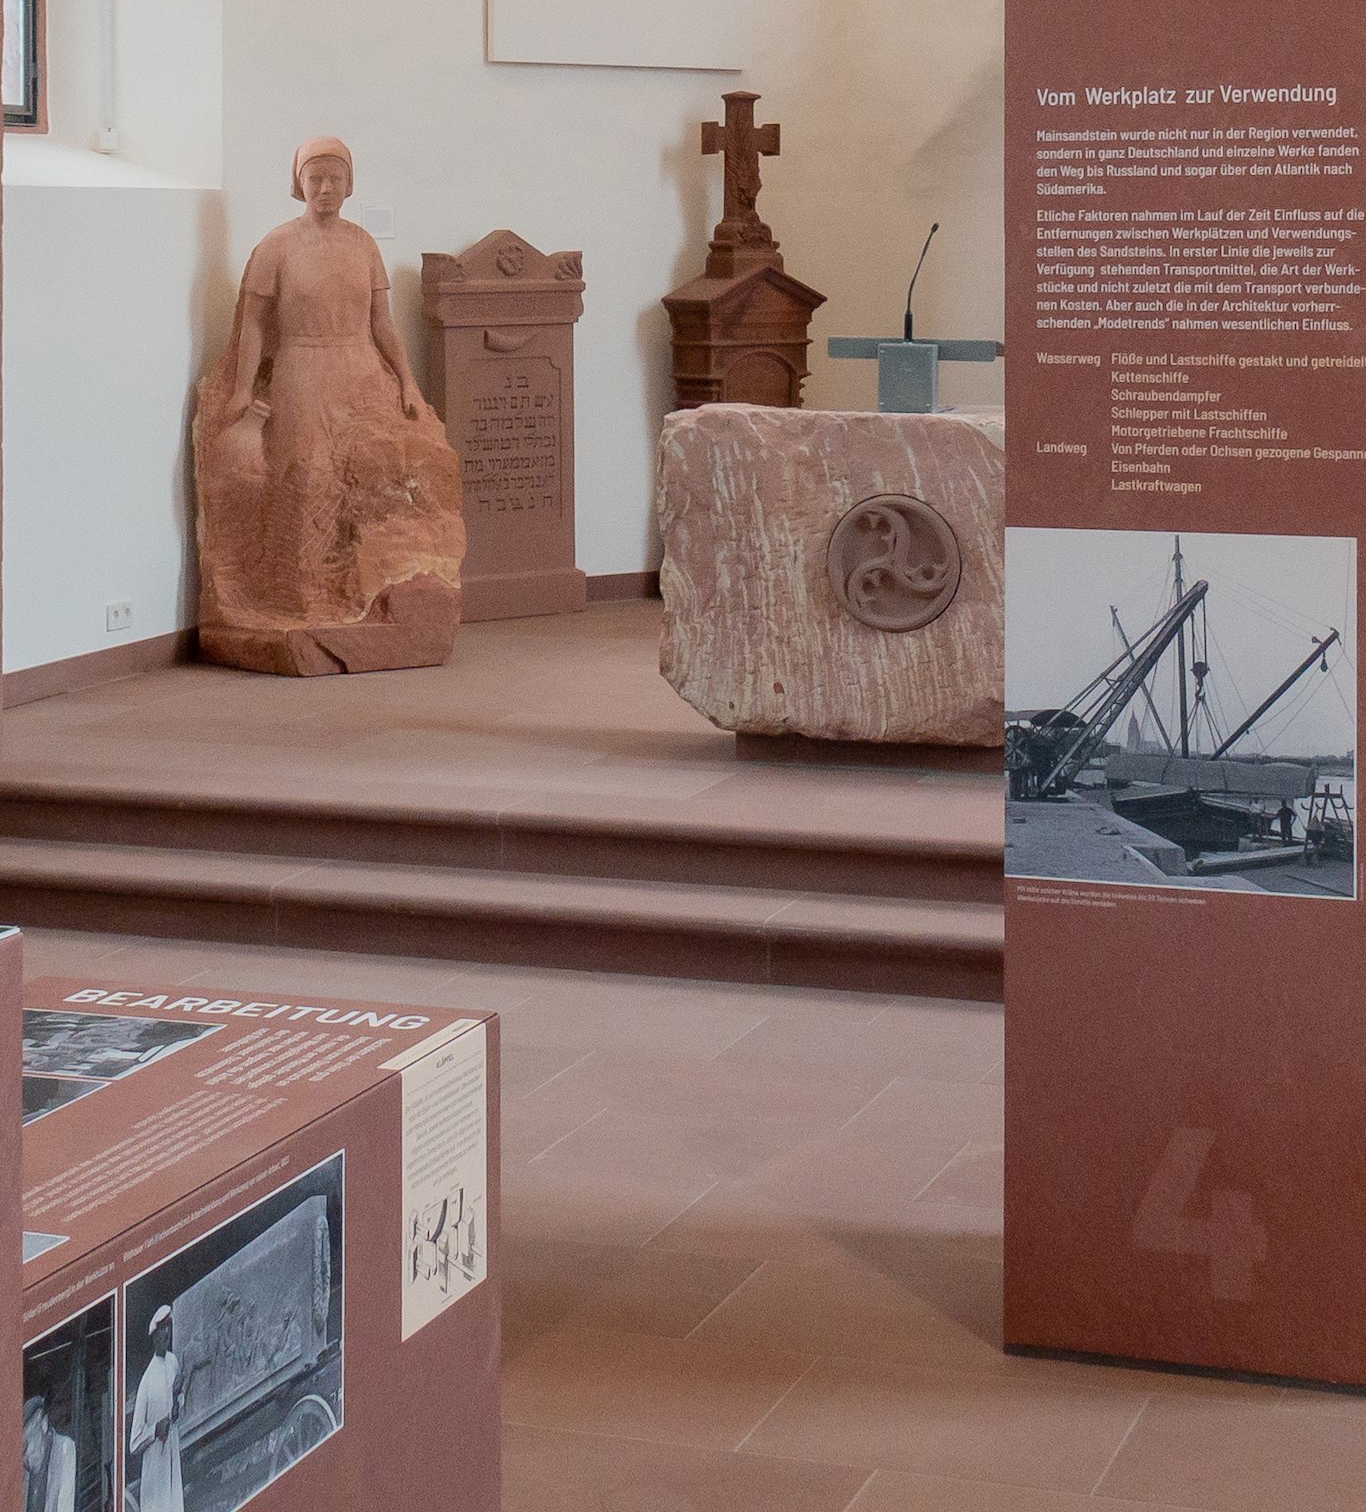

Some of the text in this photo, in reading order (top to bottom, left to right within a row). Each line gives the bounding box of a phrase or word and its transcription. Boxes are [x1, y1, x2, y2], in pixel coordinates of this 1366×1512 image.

[1036, 83, 1336, 109] Vom Werkplatz zur Verwendung
[1036, 125, 1357, 141] Mainsandstein wurde nicht nur in der Region verwendet,
[1036, 144, 1359, 161] sondern in ganz Deutschland und einzelne Werke fanden
[1036, 162, 1352, 179] den Weg bis Russland und sogar über den Atlantik nach
[1036, 182, 1106, 194] Südamerika.
[1036, 352, 1100, 367] Wasserweg
[1111, 352, 1143, 364] Flöße
[1145, 353, 1167, 364] und
[1170, 353, 1235, 366] Lastschiffe
[1238, 354, 1283, 369] gestakt
[1285, 355, 1308, 366] und
[1111, 371, 1189, 383] Kettenschiffe
[1111, 388, 1221, 404] Schraubendampfer
[1111, 406, 1266, 421] Schlepper mit Lastschiffen
[1111, 424, 1287, 440] Motorgetriebene Frachtschiffe
[1036, 441, 1087, 456] Landweg
[1111, 442, 1132, 454] Von
[1134, 442, 1179, 455] Pferden
[1181, 444, 1207, 456] oder
[1210, 444, 1252, 457] Ochsen
[1254, 448, 1310, 461] gezogene
[1111, 459, 1170, 473] Eisenbahn
[1111, 478, 1201, 494] Lastkraftwagen
[63, 987, 435, 1032] BEARBEITUNG
[1131, 1126, 1268, 1300] 4
